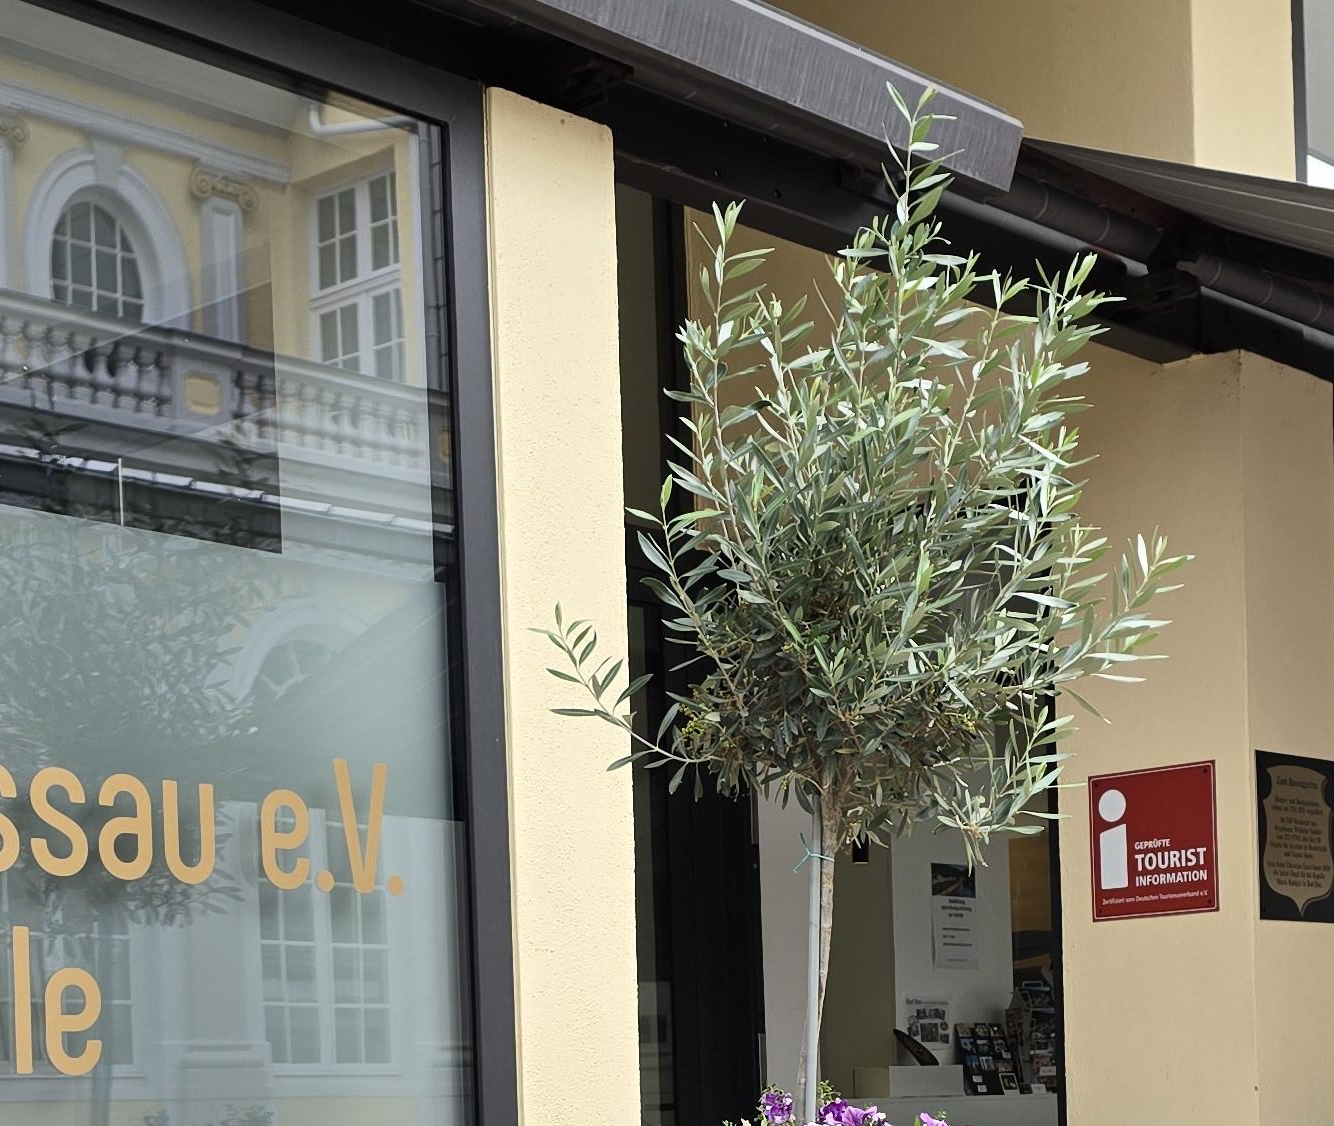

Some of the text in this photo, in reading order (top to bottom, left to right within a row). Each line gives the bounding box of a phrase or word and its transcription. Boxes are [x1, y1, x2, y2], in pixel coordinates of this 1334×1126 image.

[260, 758, 405, 897] e.V.
[1134, 838, 1171, 850] GEPRÜFTE
[1134, 847, 1207, 872] TOURIST
[1135, 869, 1208, 887] INFORMATION
